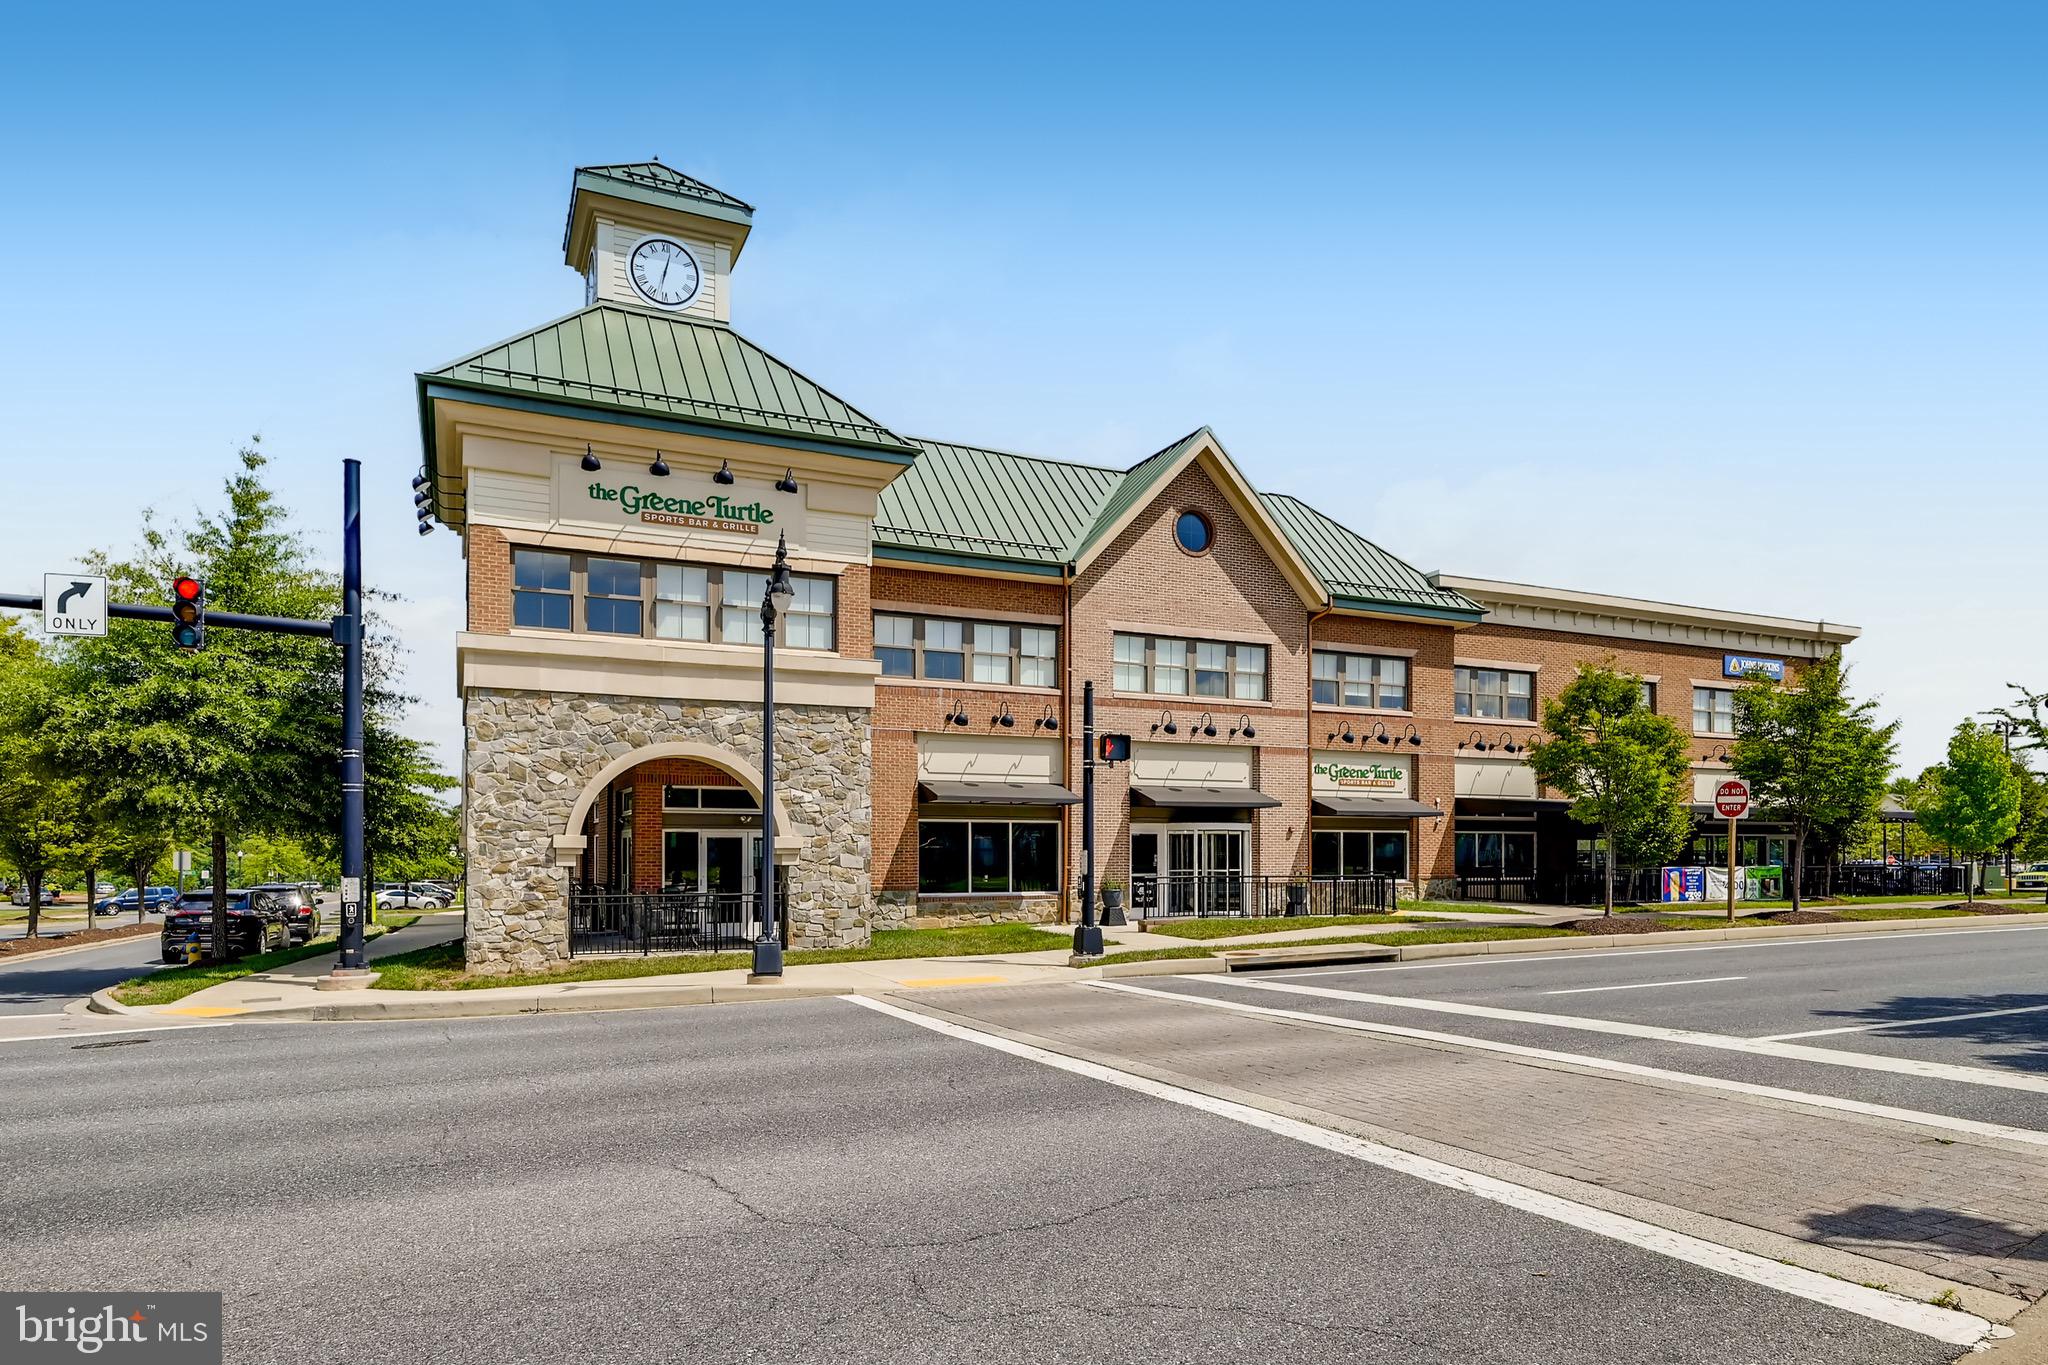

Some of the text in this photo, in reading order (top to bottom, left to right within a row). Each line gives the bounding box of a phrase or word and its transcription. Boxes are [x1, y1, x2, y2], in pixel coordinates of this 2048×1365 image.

[588, 482, 774, 524] the Greene Turtle
[644, 513, 685, 524] SPORTS
[688, 518, 708, 528] BAR
[722, 522, 756, 532] GRILLE
[52, 617, 98, 630] ONLY
[1314, 764, 1403, 782] the Greene Turtle
